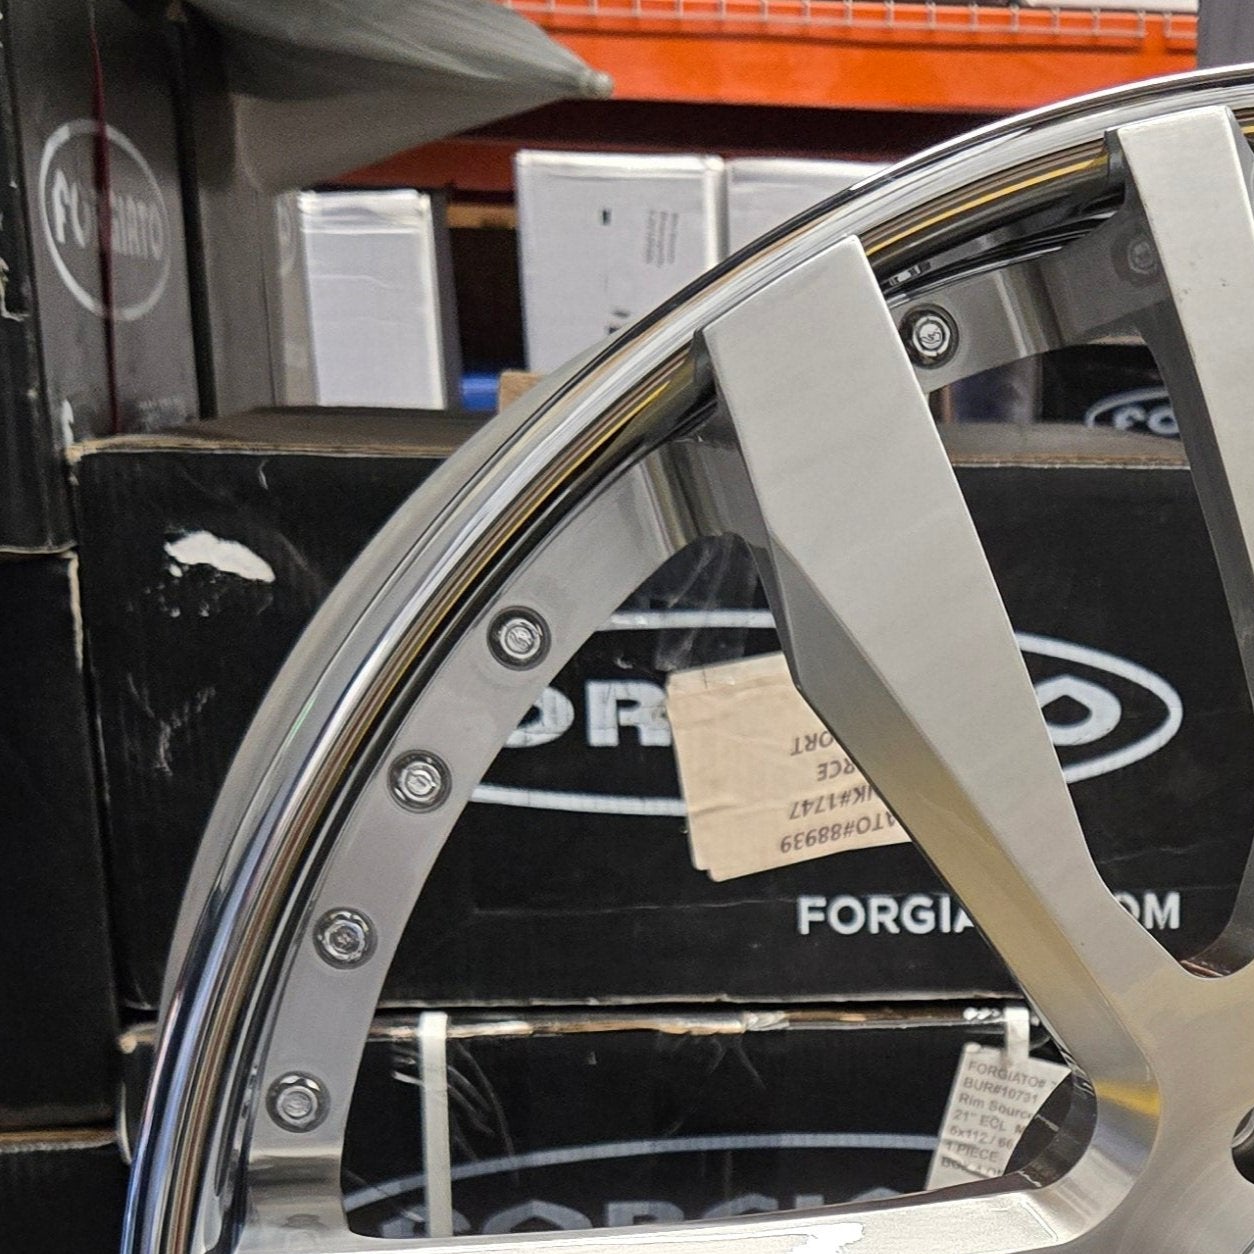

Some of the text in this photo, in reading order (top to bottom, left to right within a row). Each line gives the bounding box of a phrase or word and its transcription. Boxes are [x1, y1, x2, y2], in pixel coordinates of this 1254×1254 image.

[790, 731, 835, 756] ORT
[817, 759, 856, 782] RCE
[789, 786, 878, 821] K#1747
[780, 812, 897, 853] ATO#88939
[959, 1093, 985, 1109] Rim
